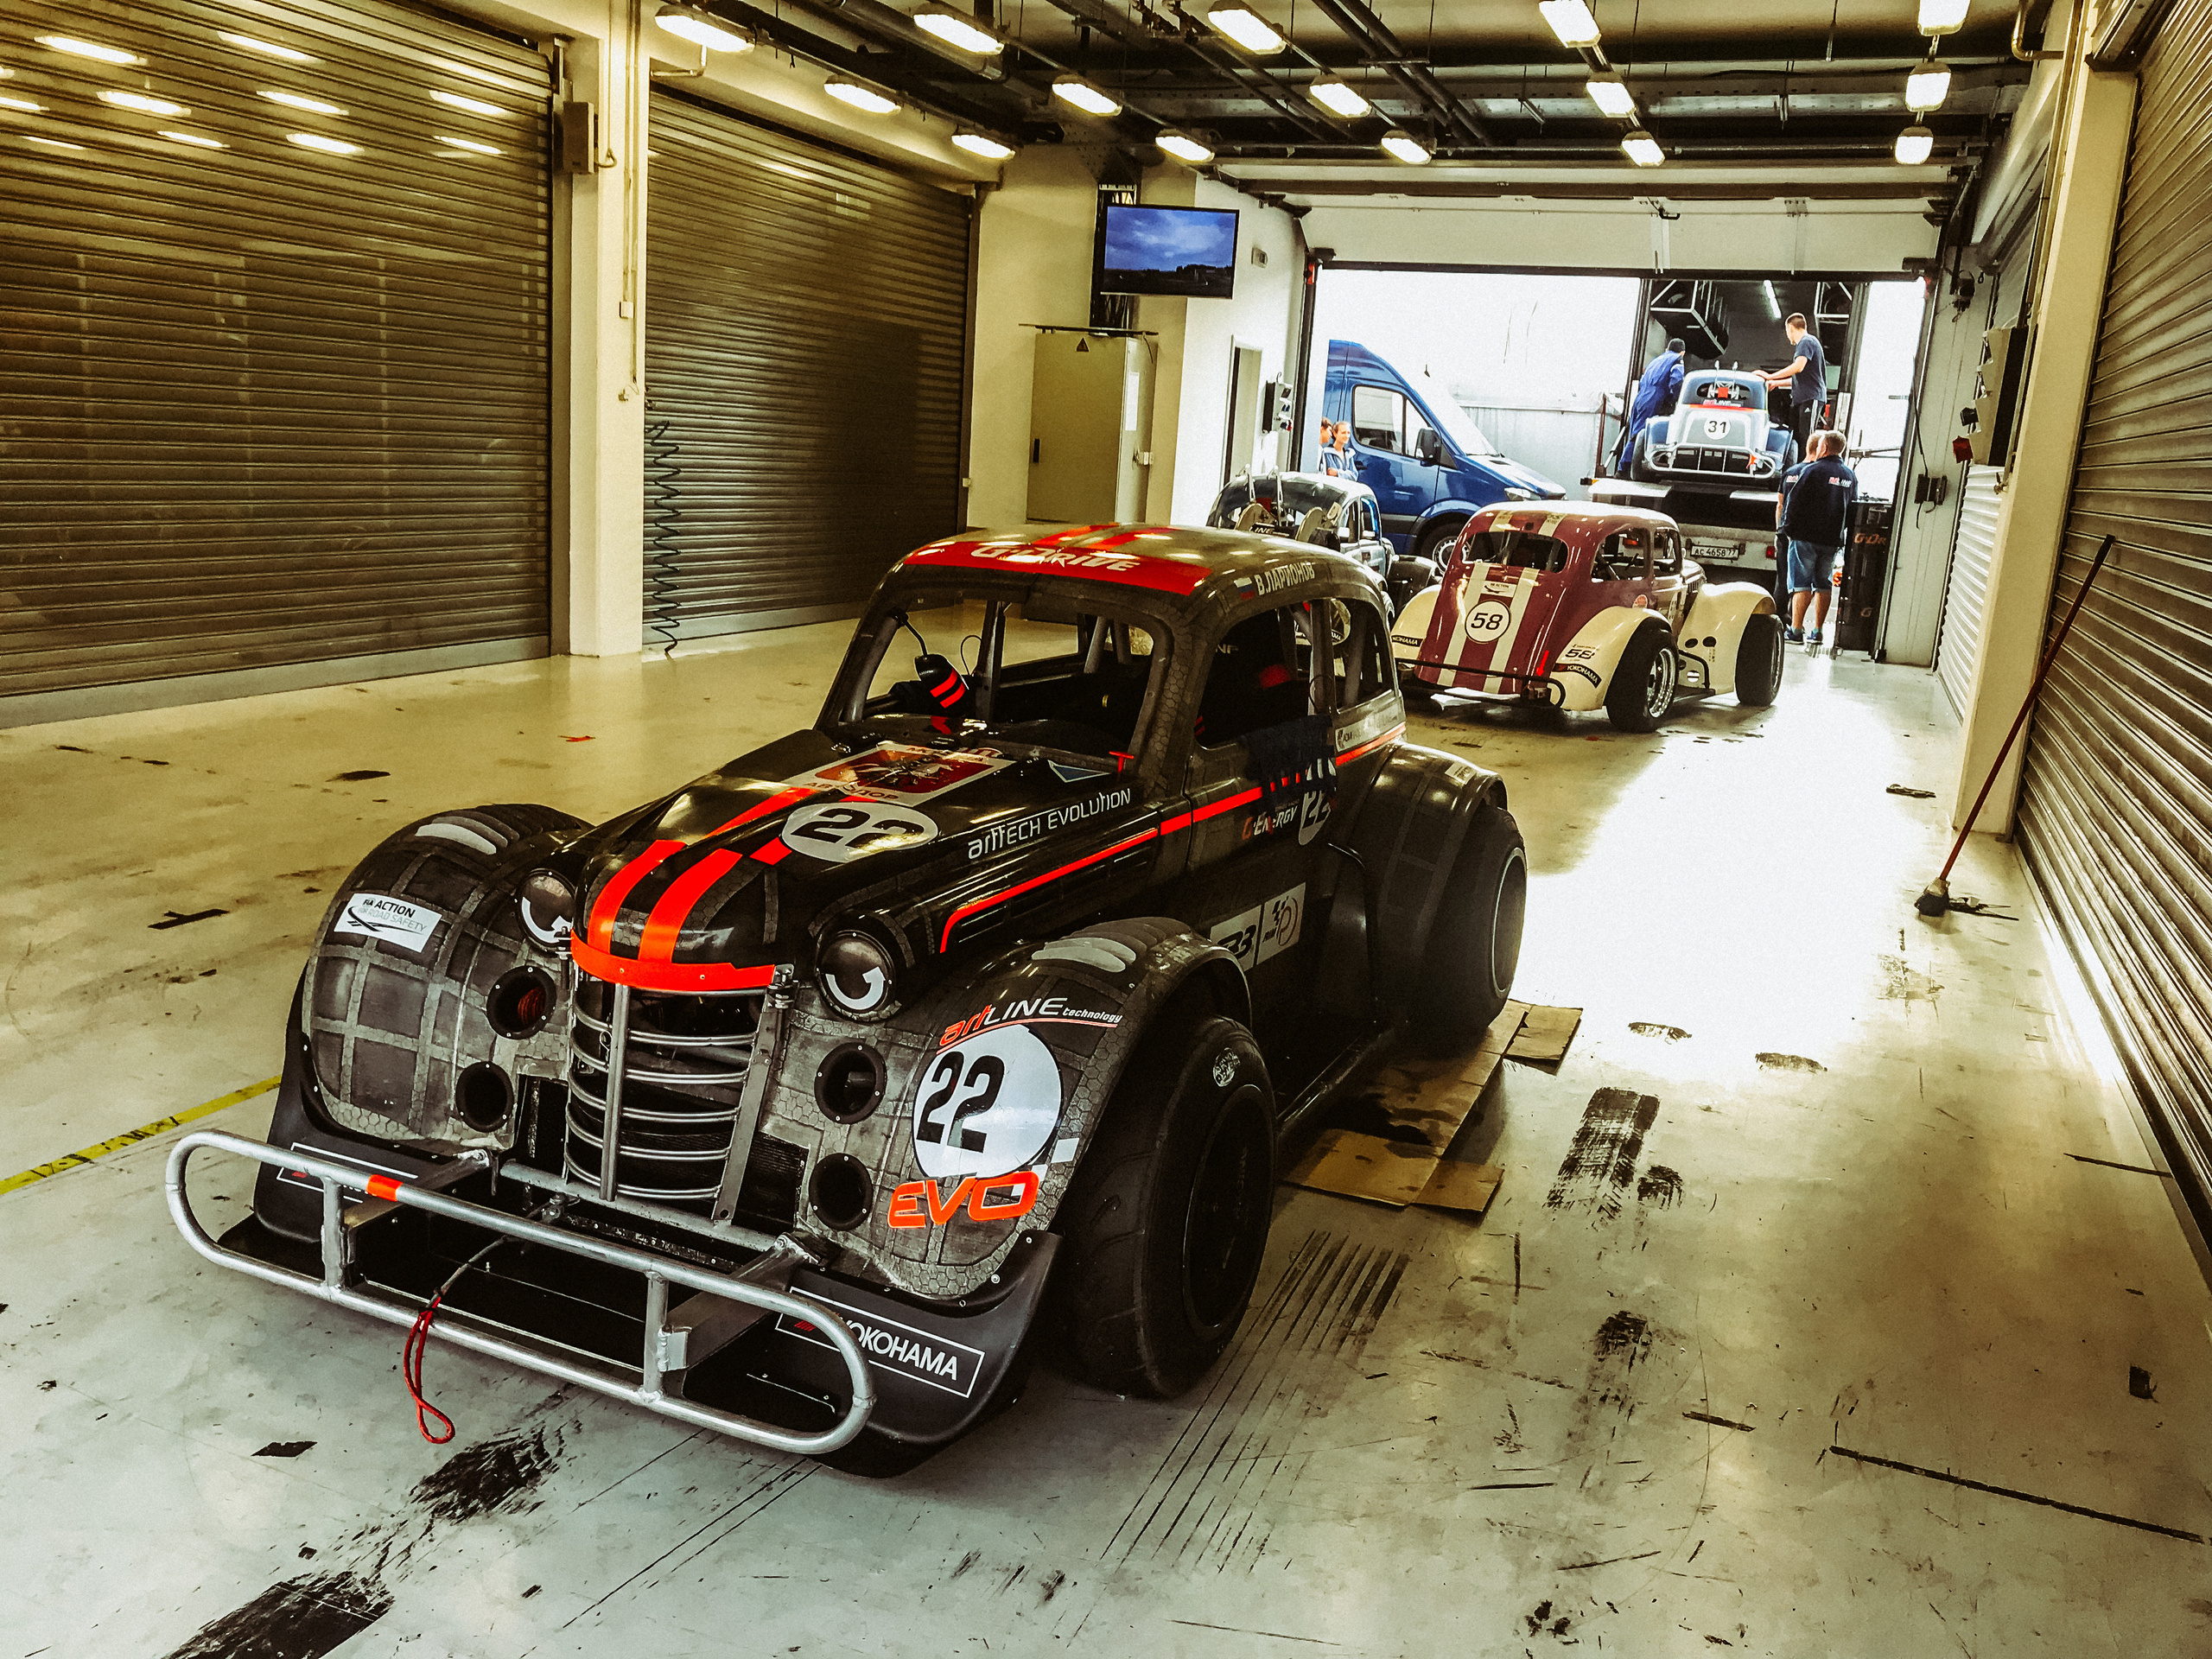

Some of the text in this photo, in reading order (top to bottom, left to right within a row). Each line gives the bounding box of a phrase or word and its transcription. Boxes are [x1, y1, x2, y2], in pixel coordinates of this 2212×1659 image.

[1707, 420, 1727, 433] 31
[1706, 548, 1726, 557] 4658
[1471, 612, 1503, 631] 58
[1565, 648, 1596, 660] 58
[1567, 664, 1599, 684] YOKOHAMA
[1047, 788, 1132, 830] EVOLUTION
[790, 808, 925, 850] 22
[374, 900, 416, 918] ACTION
[368, 908, 391, 921] ROAD
[390, 914, 428, 931] SAFETY
[1062, 1007, 1123, 1024] technology
[916, 1050, 1006, 1154] 22
[887, 1170, 1040, 1230] EVO
